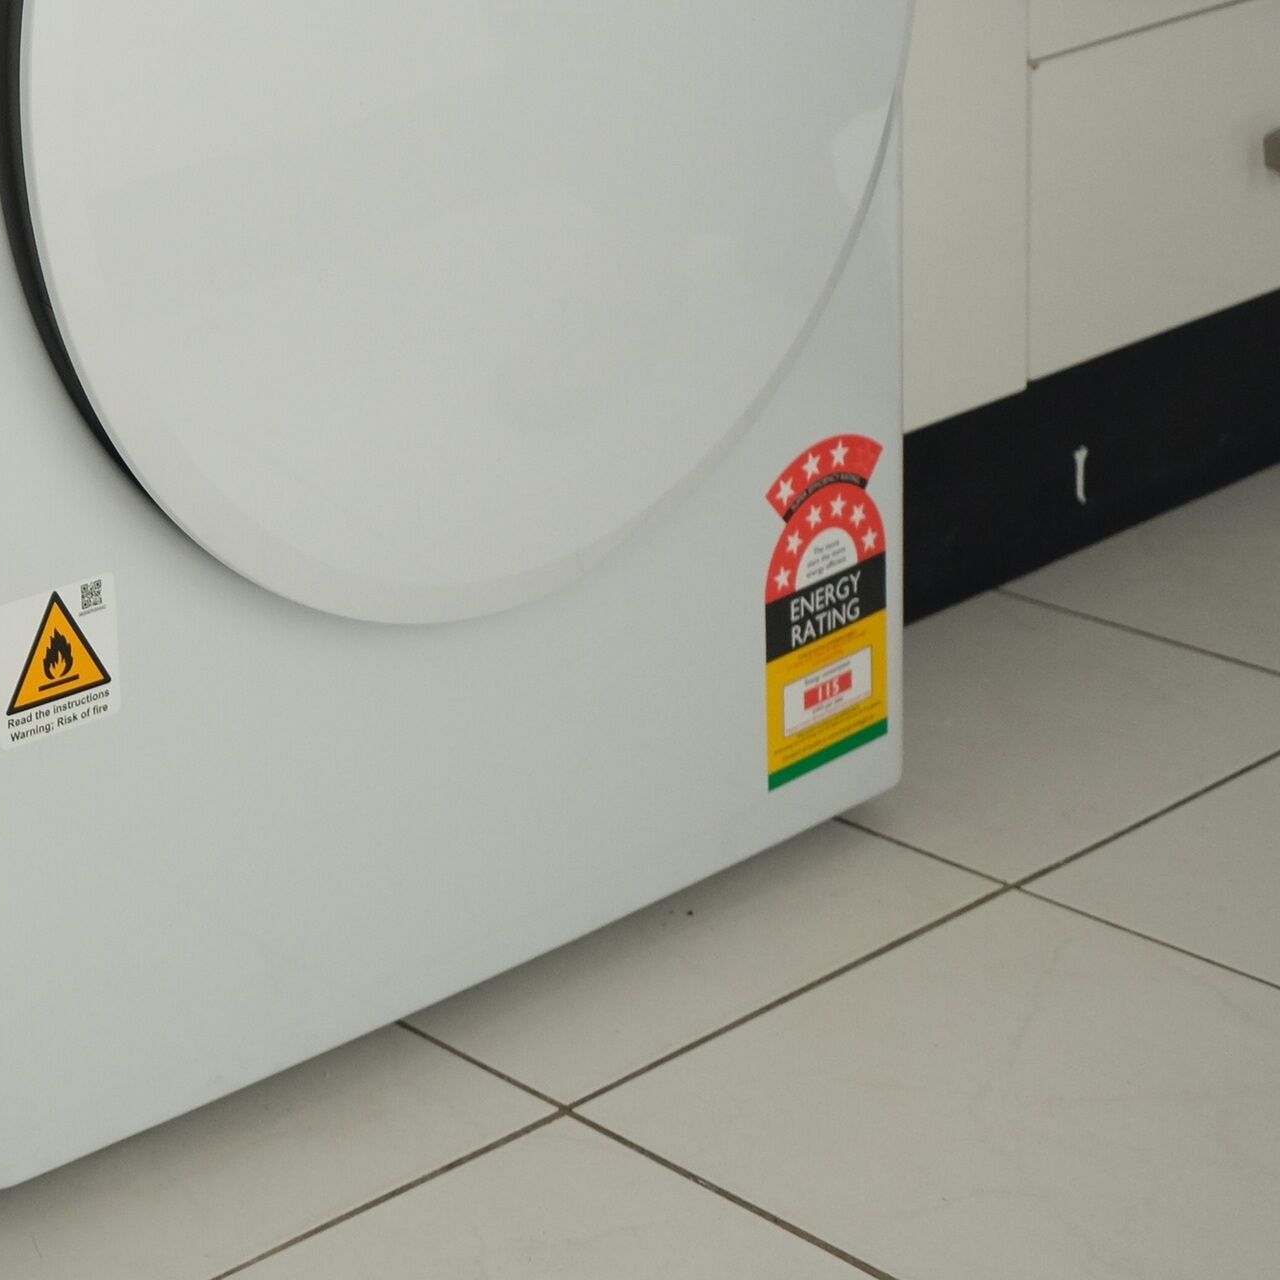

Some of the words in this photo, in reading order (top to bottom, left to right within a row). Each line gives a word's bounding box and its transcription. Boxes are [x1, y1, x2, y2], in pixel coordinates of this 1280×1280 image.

[791, 571, 861, 620] ENERGY
[792, 603, 860, 649] RATING
[8, 712, 33, 729] Read
[35, 707, 51, 721] the
[53, 688, 110, 713] instructions
[818, 677, 840, 701] 115
[57, 714, 78, 727] Risk
[81, 708, 91, 721] of
[93, 702, 108, 716] fire
